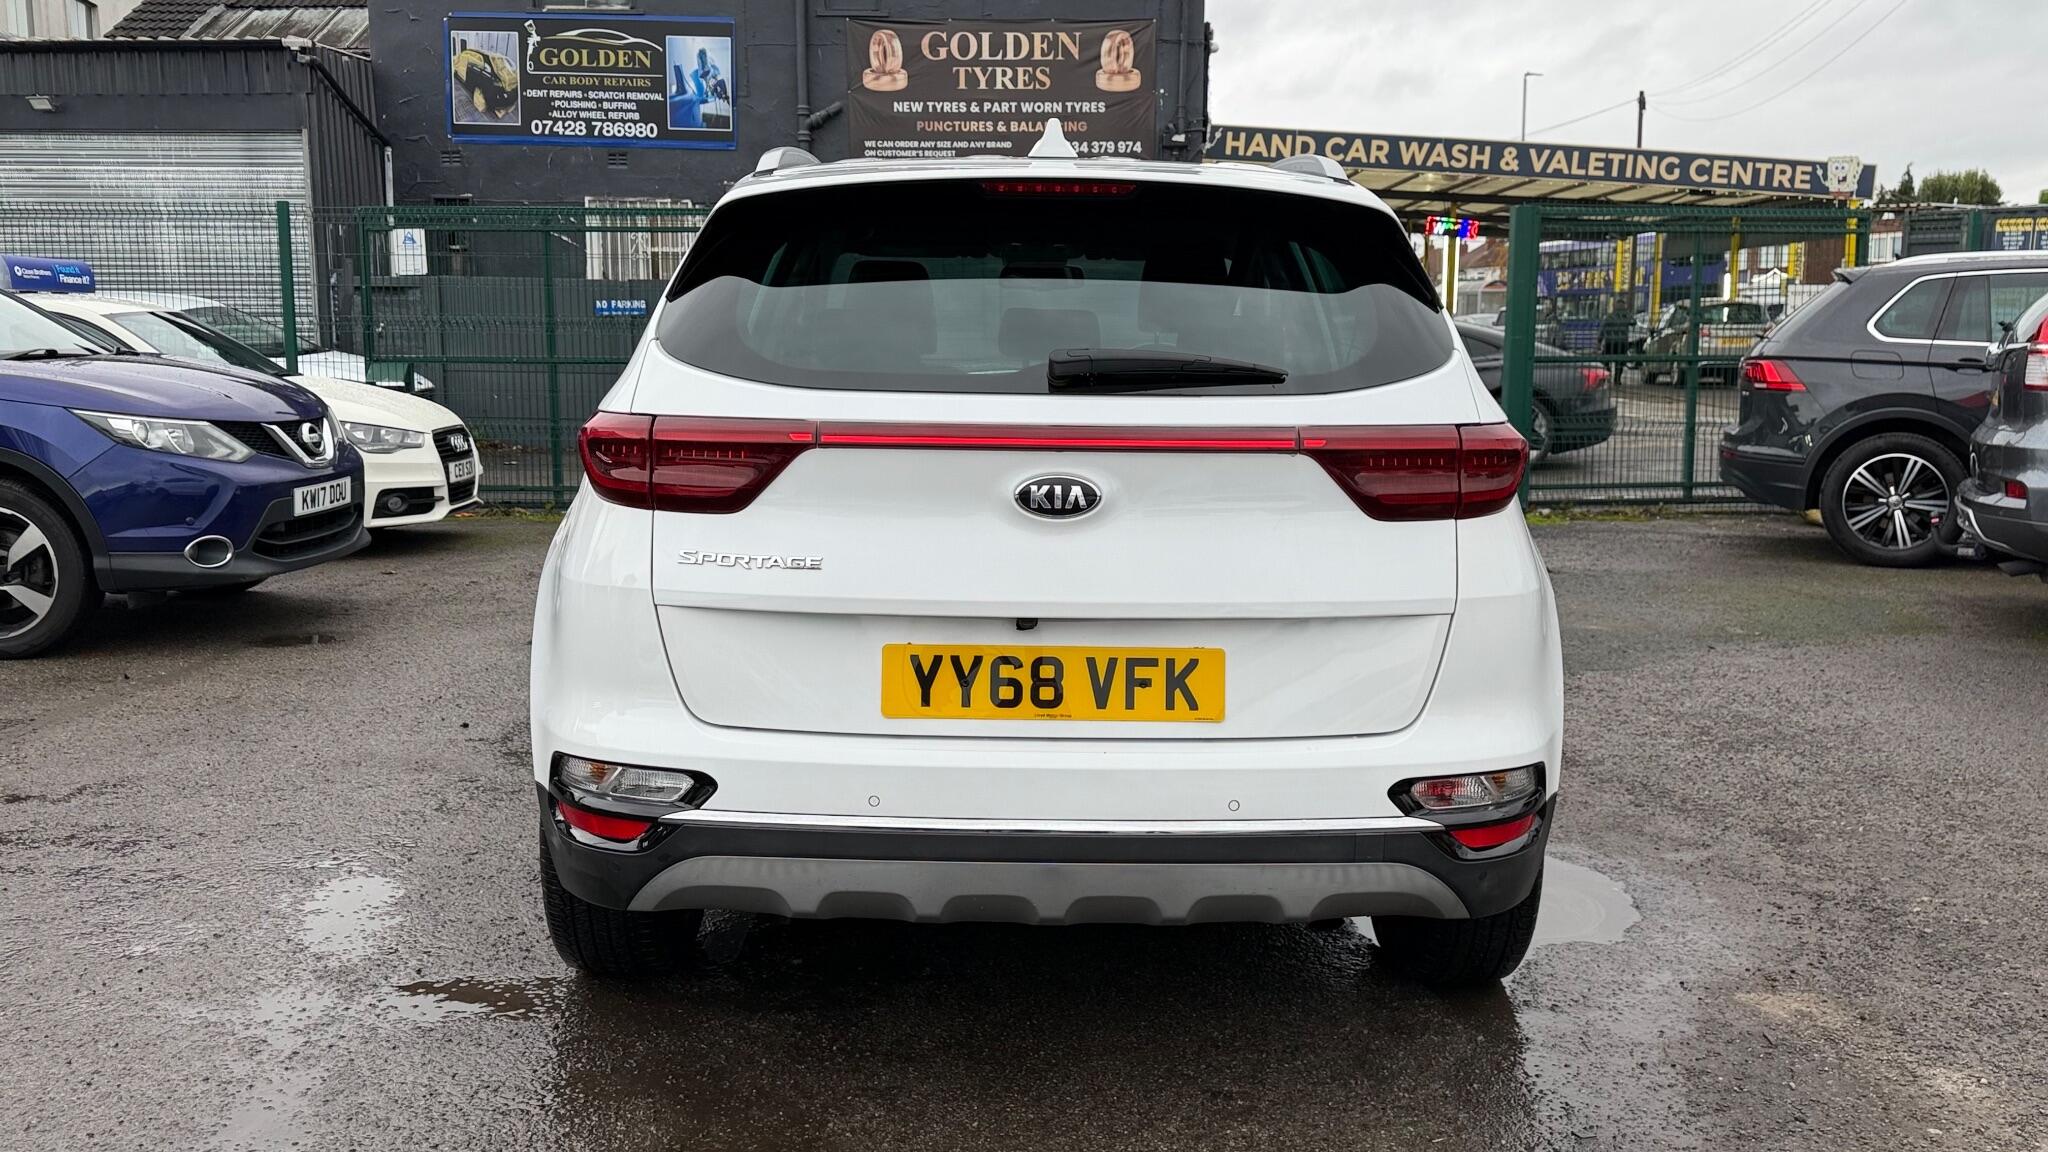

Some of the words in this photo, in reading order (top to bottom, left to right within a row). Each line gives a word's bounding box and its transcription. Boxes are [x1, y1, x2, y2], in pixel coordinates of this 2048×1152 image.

[921, 31, 1082, 61] GOLDEN
[540, 47, 653, 69] GOLDEN
[543, 75, 567, 85] CAR
[570, 76, 600, 86] BODY
[604, 77, 651, 87] REPAIRS
[952, 66, 1051, 90] TYRES
[527, 90, 548, 98] DENT
[550, 90, 582, 98] REPAIRS
[588, 91, 625, 99] SCRATCH
[627, 92, 664, 100] REMOVAL
[555, 101, 597, 109] POLISHING
[603, 102, 637, 110] BUFFING
[893, 101, 924, 113] NEW
[927, 101, 967, 113] TYRES
[970, 101, 980, 113] &
[983, 101, 1017, 113] PART
[1021, 102, 1062, 113] WORN
[1065, 102, 1106, 113] TYRES
[552, 110, 578, 118] ALLOY
[580, 111, 606, 119] WHEEL
[608, 111, 640, 120] REFURB
[531, 120, 587, 135] 07428
[591, 121, 658, 138] 786980
[917, 121, 994, 132] PUNCTURES
[996, 121, 1007, 132] &
[1010, 121, 1088, 132] BALAING
[864, 140, 876, 148] WE
[877, 140, 894, 148] CAN
[894, 140, 919, 148] ORDER
[919, 140, 935, 148] ANY
[936, 140, 951, 148] SIZE
[952, 140, 969, 148] AND
[1091, 141, 1115, 153] 379
[1117, 141, 1142, 153] 974
[1225, 130, 1316, 158] HAND
[1324, 136, 1389, 165] CAR
[1399, 140, 1491, 170] WASH
[1500, 146, 1519, 171] &
[1529, 148, 1680, 181] VALETING
[1689, 158, 1812, 190] CENTRE
[596, 300, 608, 308] NO
[611, 300, 646, 308] PARKING
[302, 485, 327, 511] KW17
[1029, 484, 1088, 509] KIA
[677, 549, 823, 570] SPORTAGE
[909, 654, 1064, 709] YY68
[1086, 656, 1200, 711] VFK
